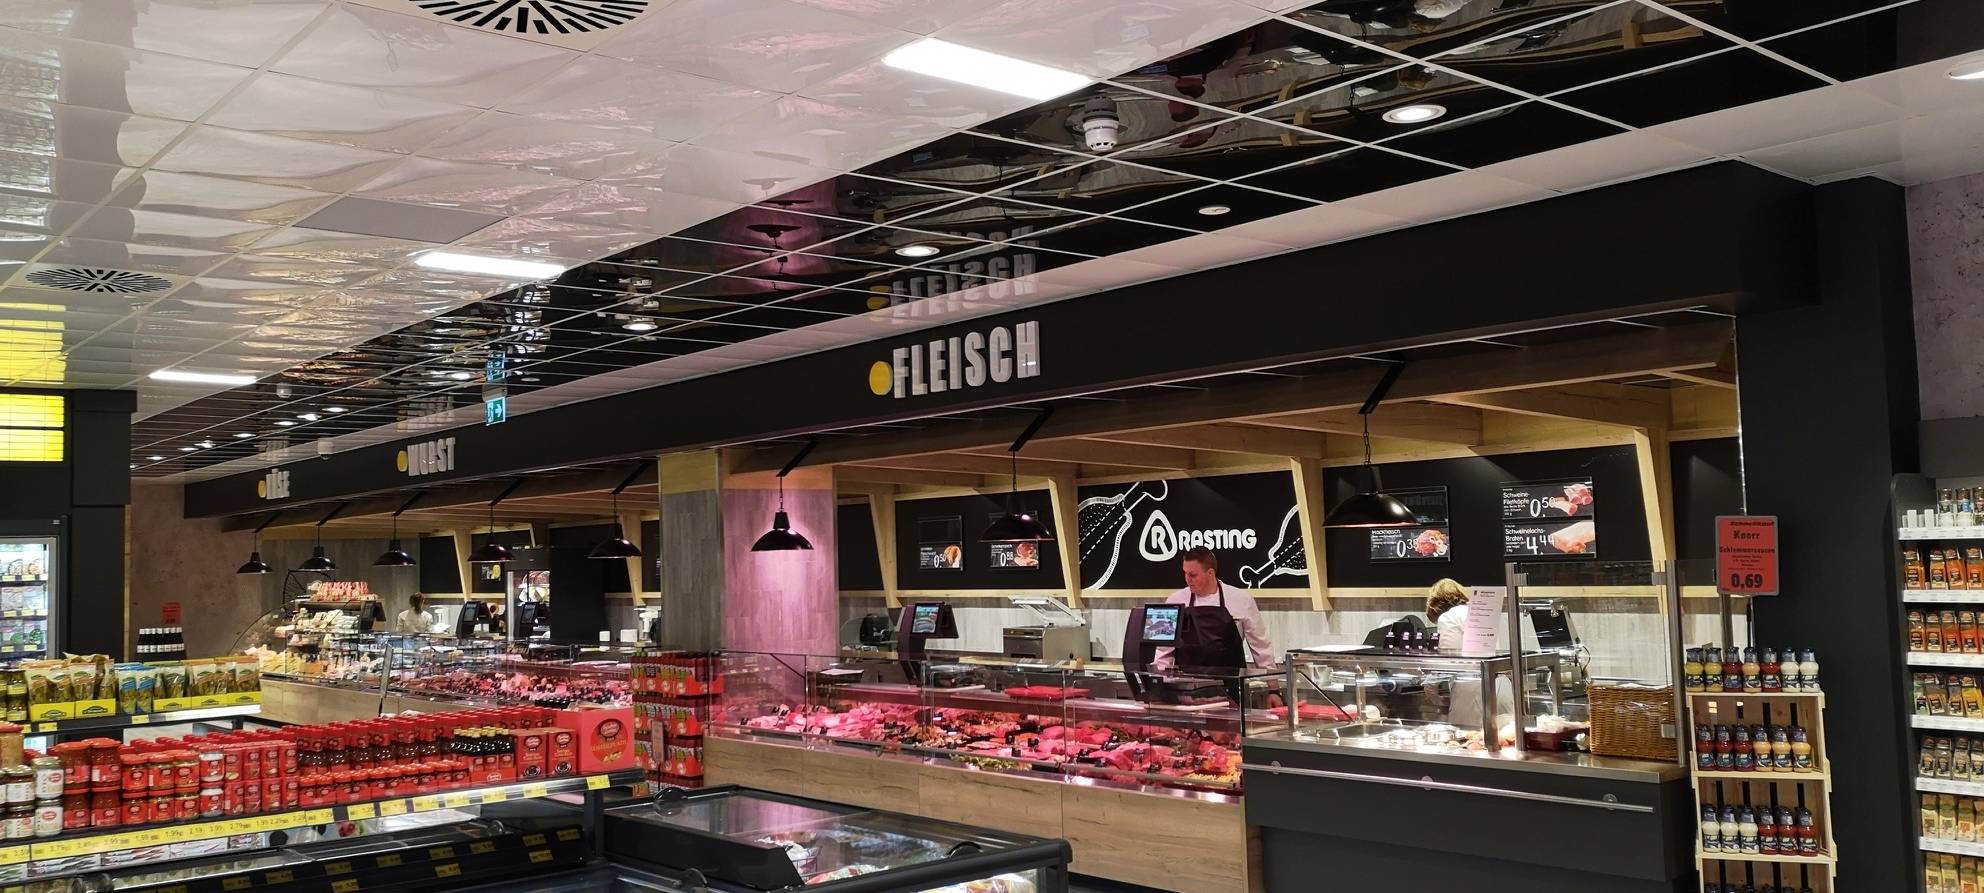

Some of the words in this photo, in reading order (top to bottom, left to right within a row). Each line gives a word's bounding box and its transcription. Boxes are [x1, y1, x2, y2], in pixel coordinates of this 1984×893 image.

[893, 320, 1040, 398] FLEISCH
[407, 437, 456, 477] WURST
[1178, 528, 1257, 552] RASTING
[1733, 530, 1760, 539] Knorr
[1731, 573, 1763, 589] 0,69
